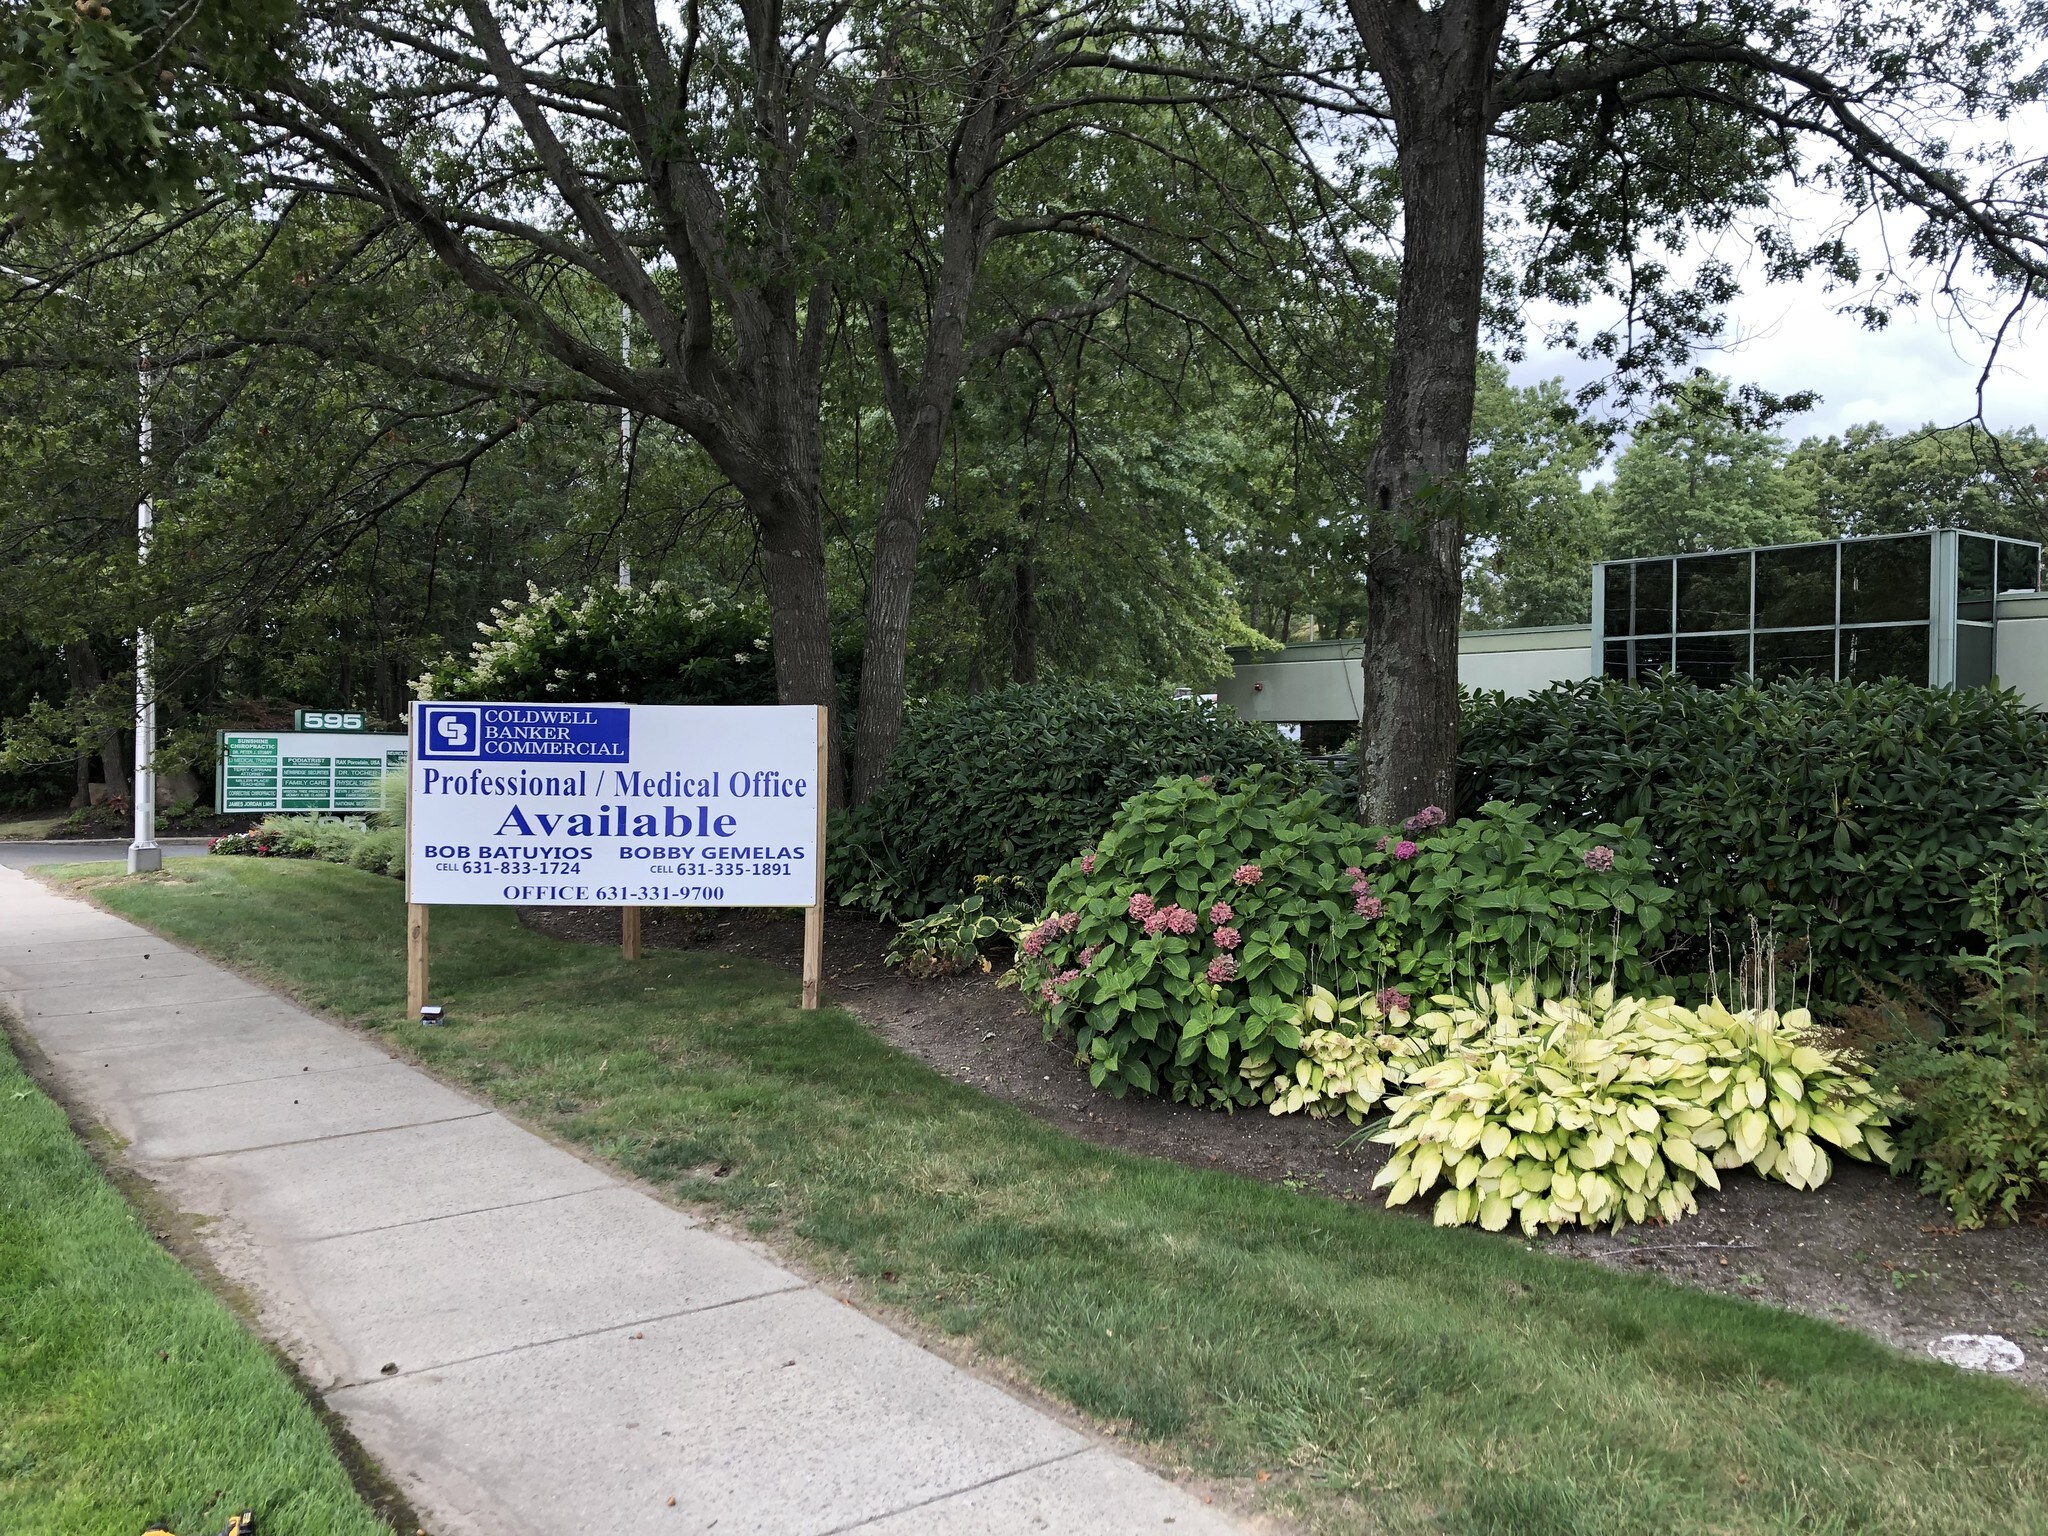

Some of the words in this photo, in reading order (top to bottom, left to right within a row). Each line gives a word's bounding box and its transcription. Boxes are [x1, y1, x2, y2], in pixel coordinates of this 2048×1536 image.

[304, 712, 362, 729] 595
[484, 709, 598, 725] COLDWELL
[485, 725, 570, 740] BANKER
[484, 741, 624, 756] COMMERCIAL
[422, 767, 586, 797] Professional
[595, 769, 605, 797] /
[613, 770, 719, 798] Medical
[729, 770, 807, 798] Office
[493, 803, 737, 838] Available
[425, 845, 471, 858] BOB
[478, 846, 593, 860] BATUYIOS
[619, 846, 695, 859] BOBBY
[701, 846, 805, 860] GEMELAS
[436, 862, 460, 872] CELL
[462, 861, 581, 875] 631-833-1724
[650, 865, 674, 874] CELL
[676, 863, 792, 876] 631-335-1891
[503, 885, 590, 901] OFFICE
[596, 886, 725, 901] 631-331-9700
